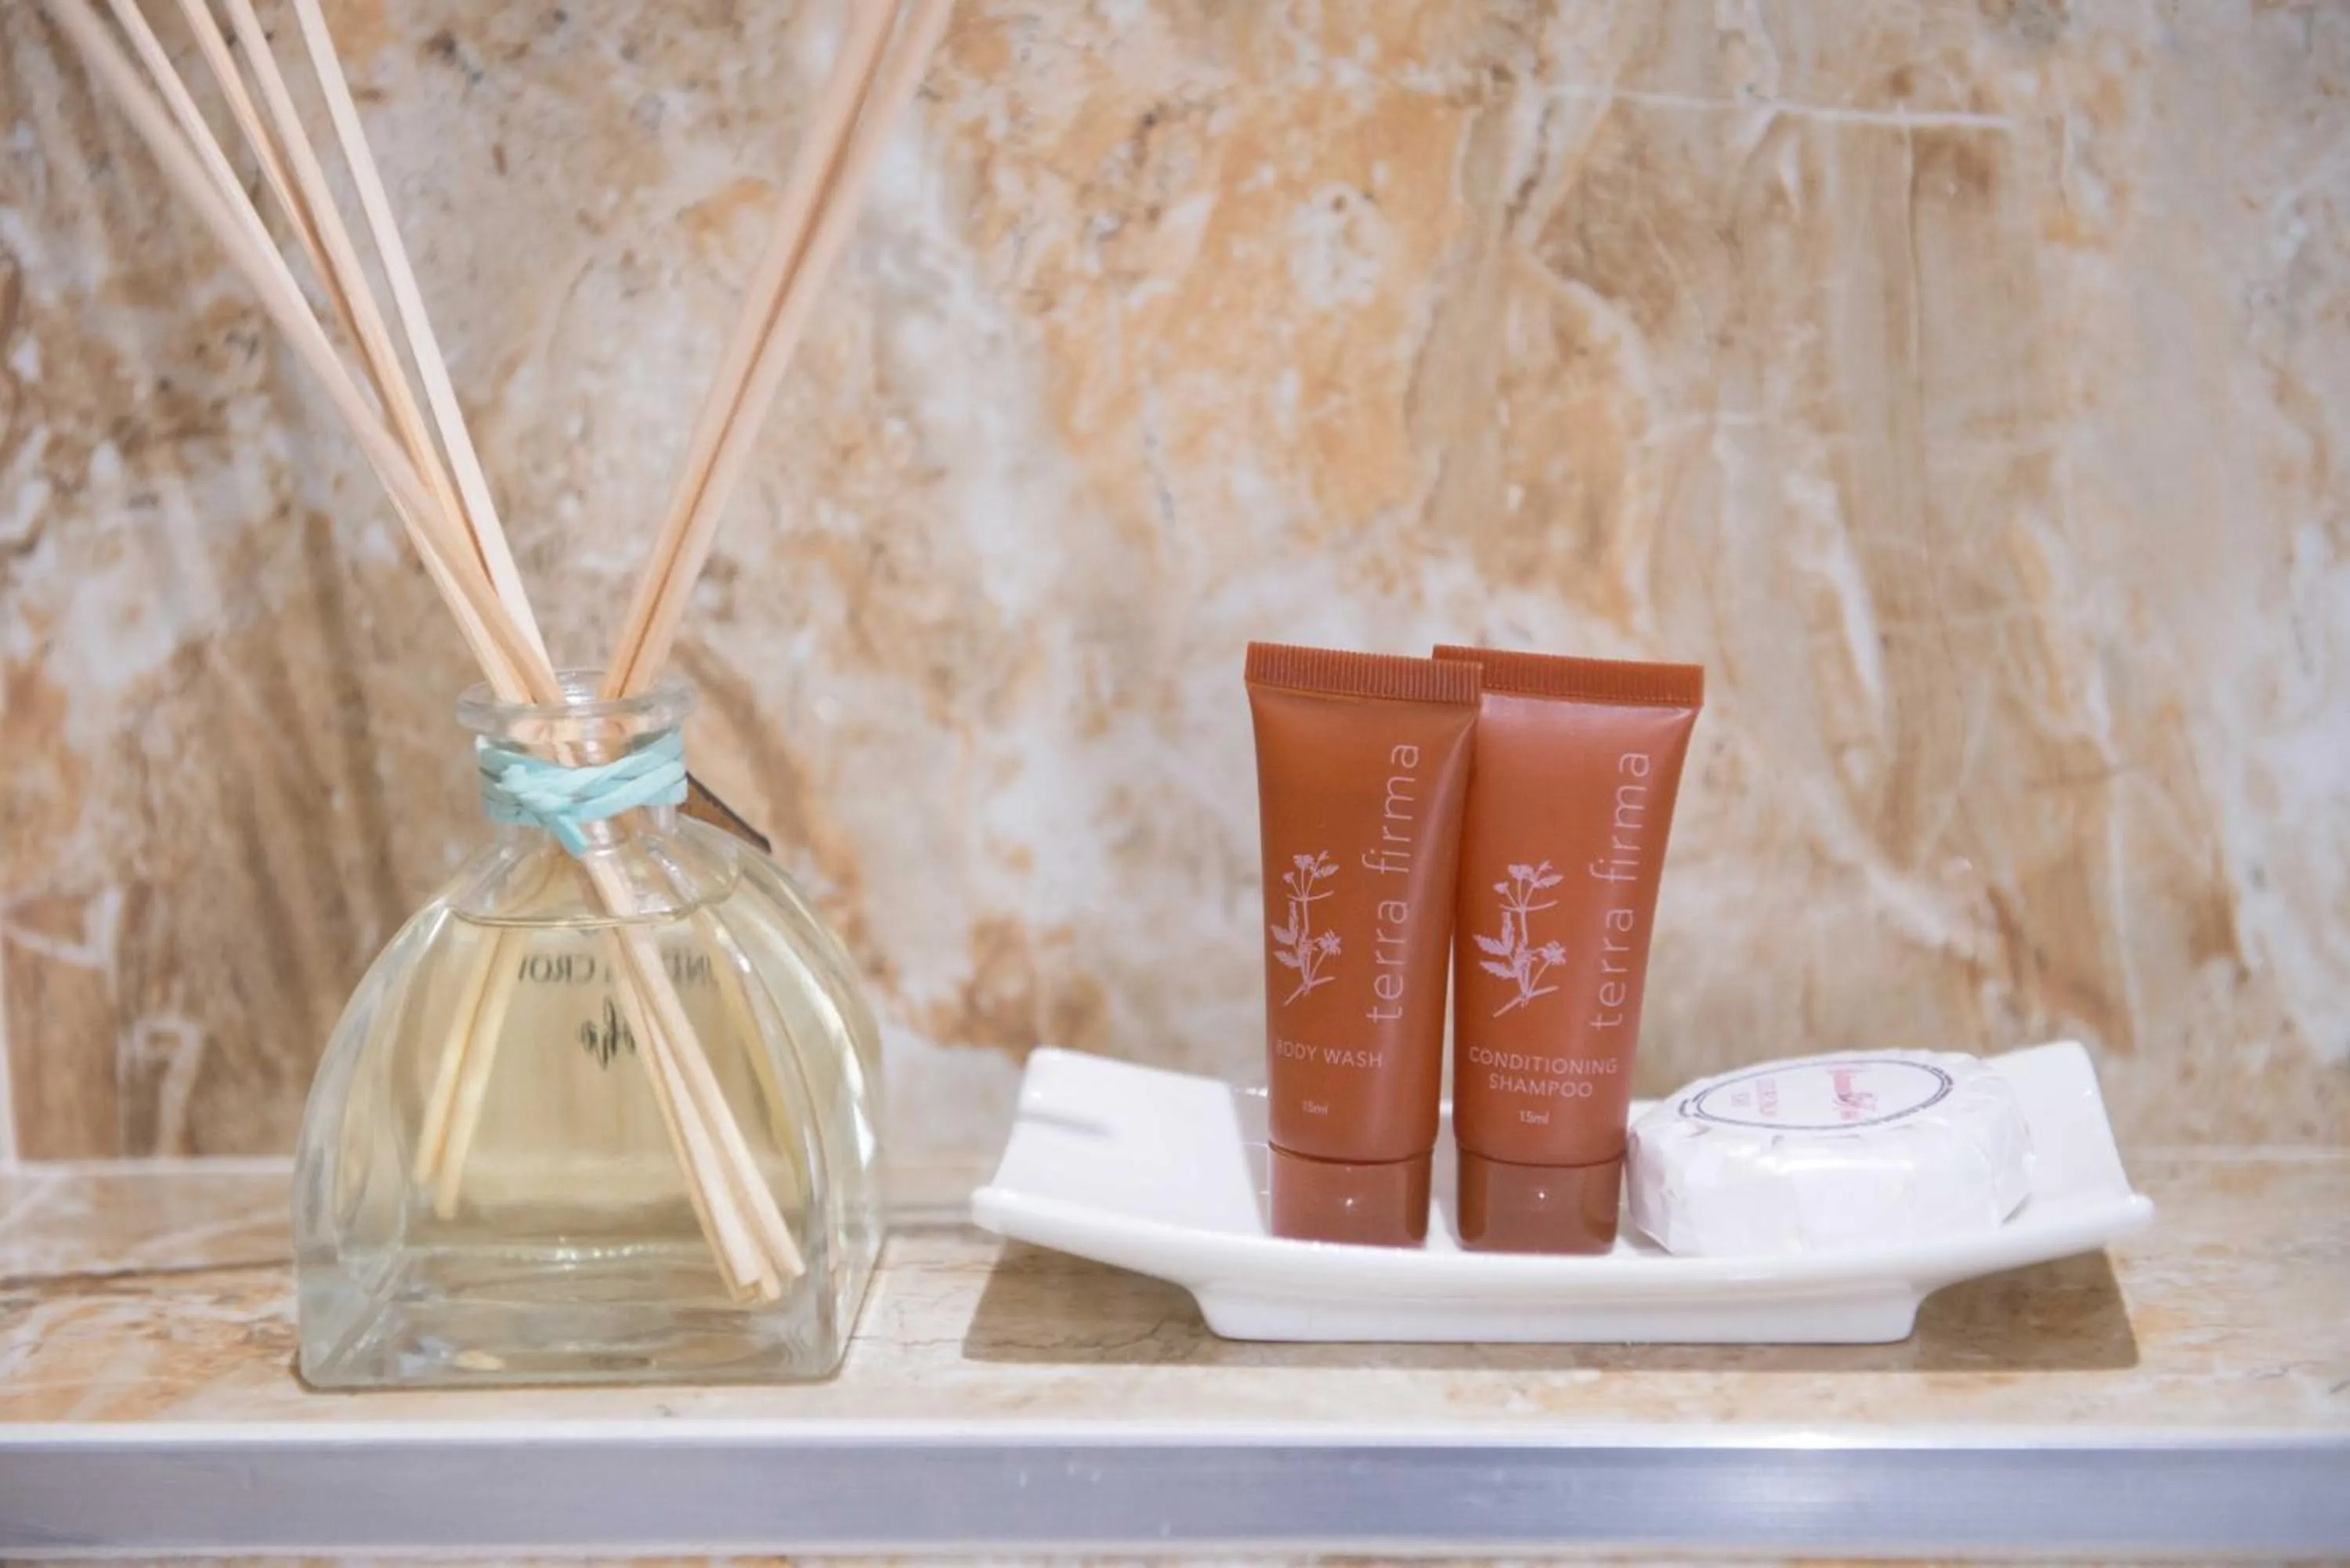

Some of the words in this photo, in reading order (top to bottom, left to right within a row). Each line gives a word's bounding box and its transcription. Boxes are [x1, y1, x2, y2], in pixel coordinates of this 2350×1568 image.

[1361, 744, 1419, 874] firma
[1589, 752, 1650, 883] firma
[1365, 900, 1408, 1024] terra
[1589, 908, 1634, 1031] terra
[1323, 1047, 1383, 1068] WASH
[1468, 1046, 1618, 1075] CONDITIONING
[1488, 1071, 1593, 1098] SHAMPOO
[1518, 1109, 1551, 1125] 15ml
